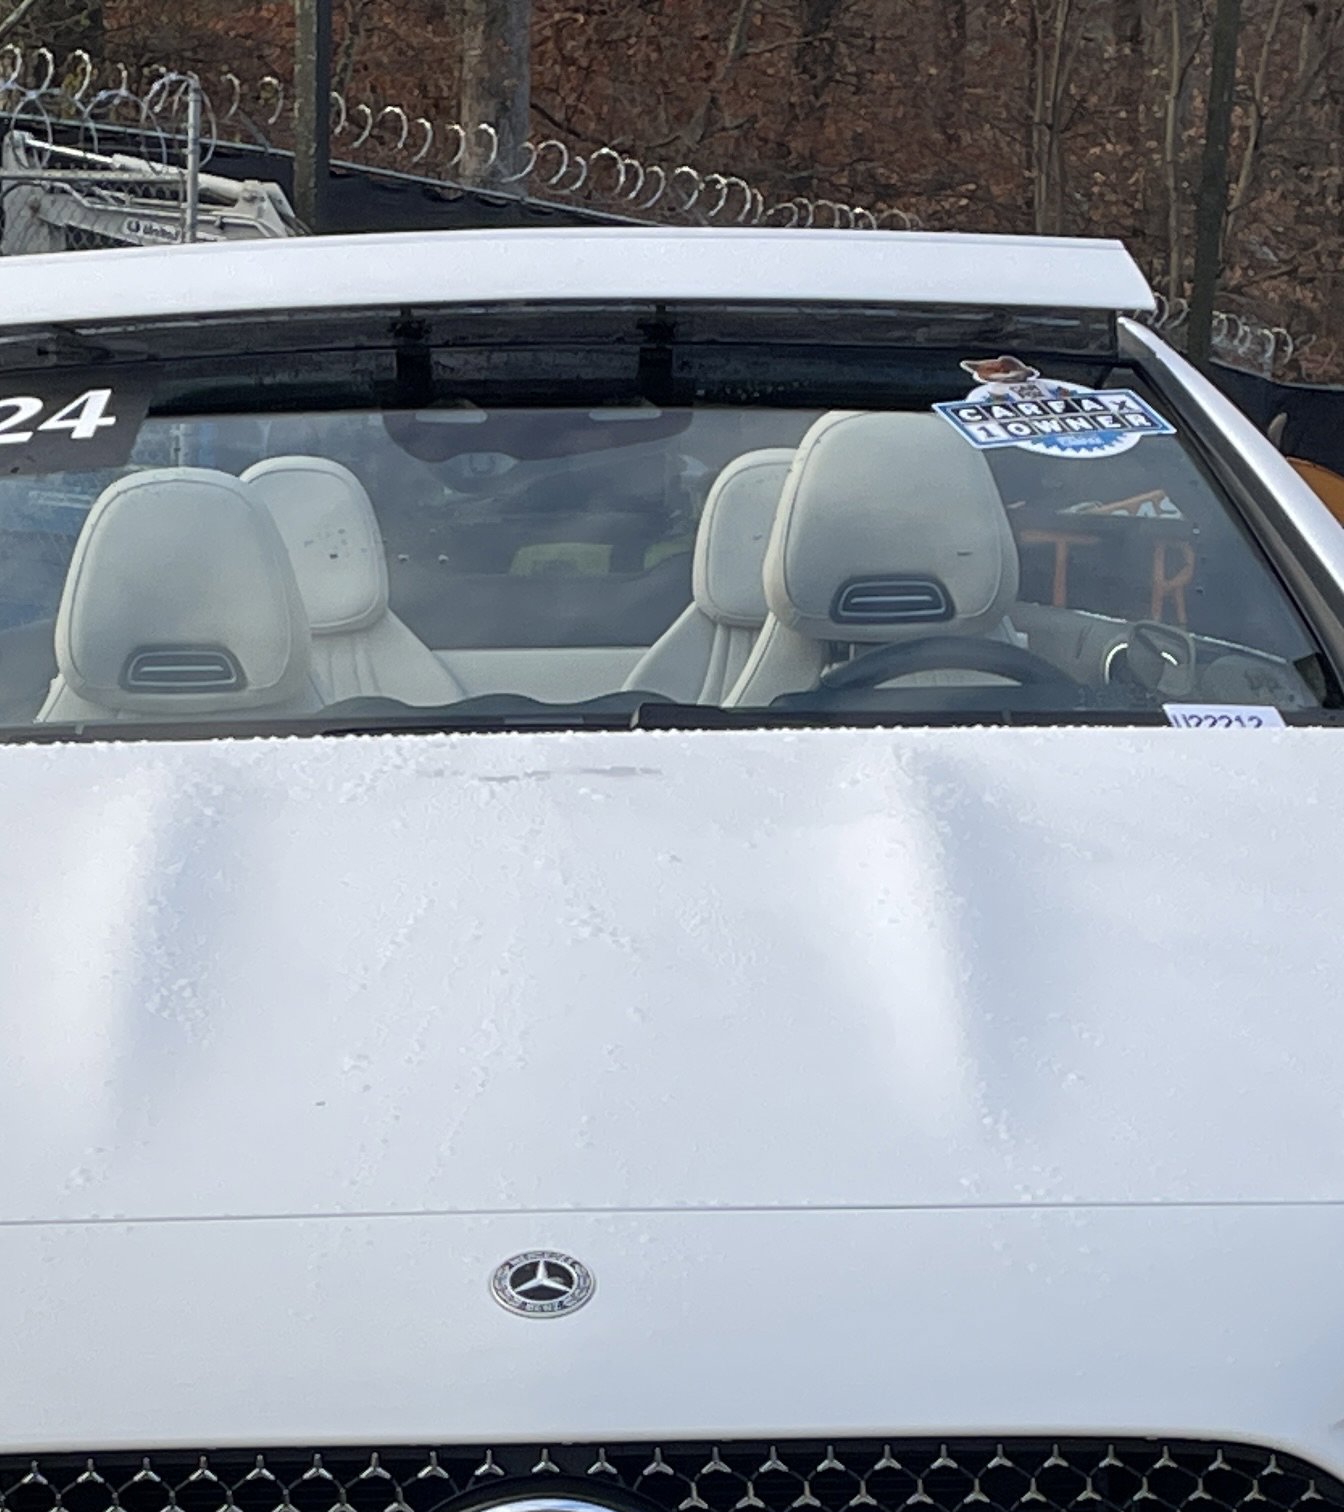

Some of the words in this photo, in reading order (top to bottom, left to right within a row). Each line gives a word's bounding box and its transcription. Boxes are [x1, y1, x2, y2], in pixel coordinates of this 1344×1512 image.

[958, 396, 1135, 423] CARFAX
[975, 424, 999, 440] 1
[1006, 412, 1152, 438] OWNER
